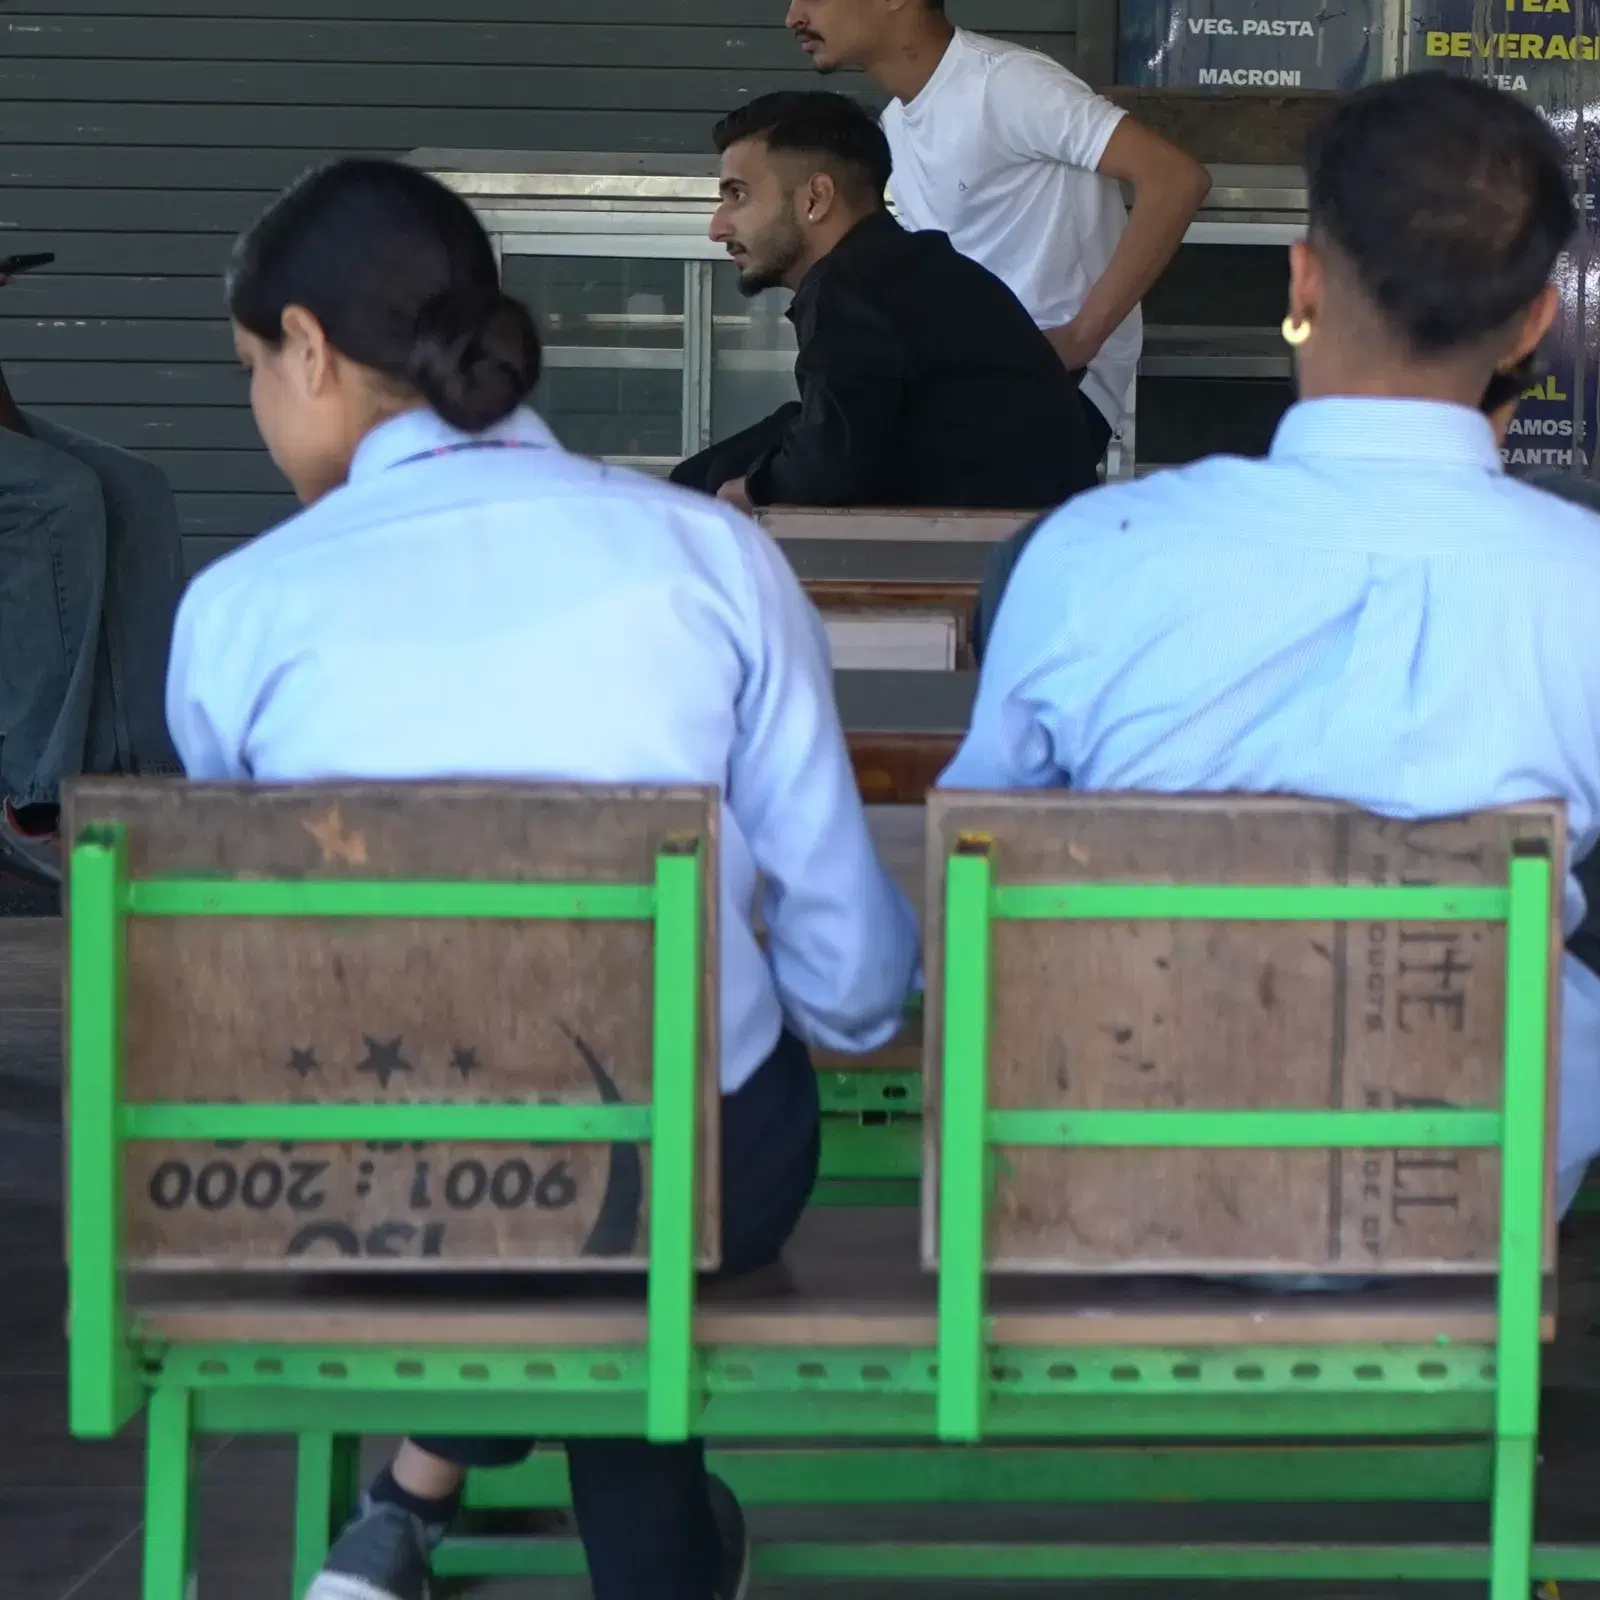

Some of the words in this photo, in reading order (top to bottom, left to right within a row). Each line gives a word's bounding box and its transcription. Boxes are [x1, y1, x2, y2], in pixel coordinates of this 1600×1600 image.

[1188, 18, 1239, 35] VEG.
[1243, 20, 1315, 37] PASTA
[1199, 68, 1301, 86] MACRONI
[148, 1158, 331, 1211] 2000
[410, 1158, 578, 1211] 9001
